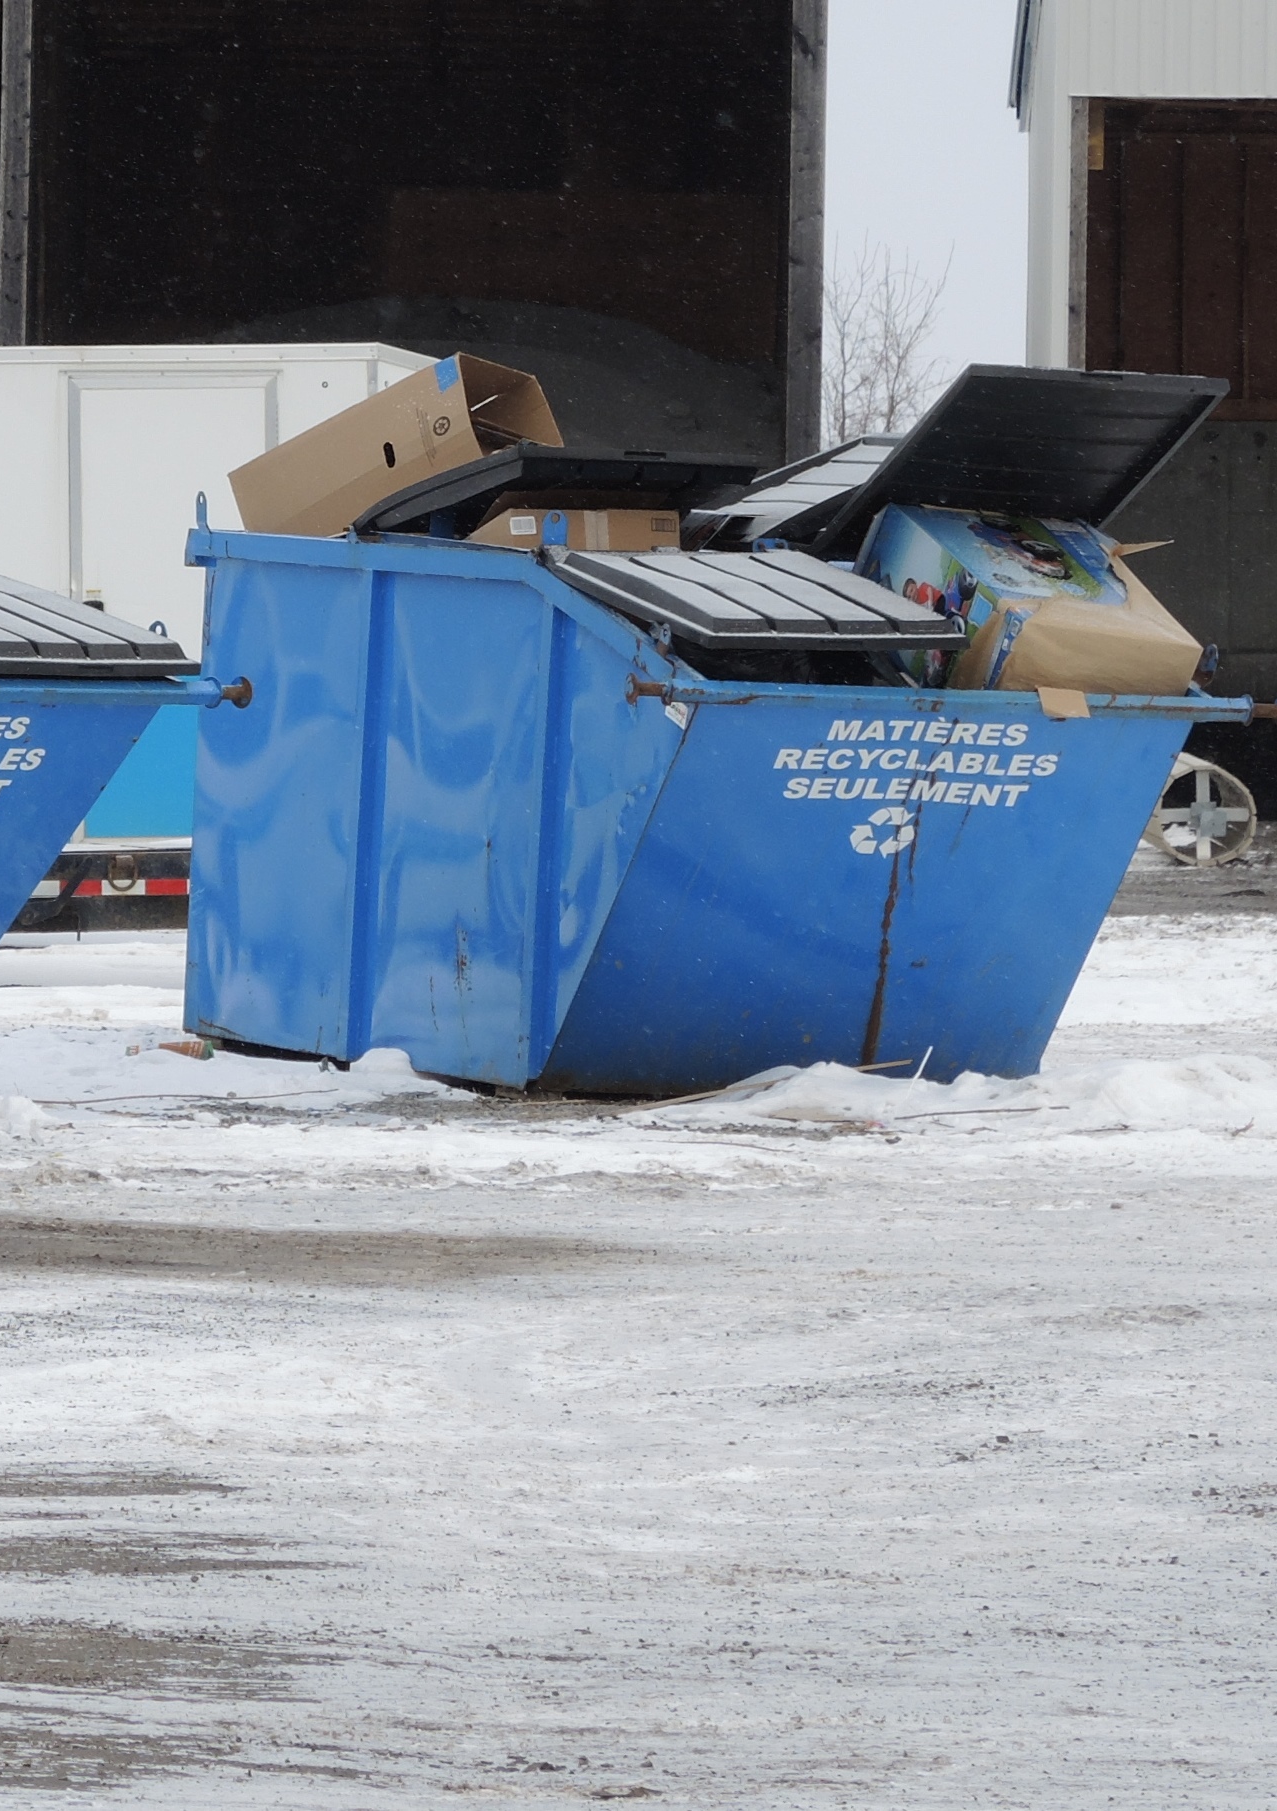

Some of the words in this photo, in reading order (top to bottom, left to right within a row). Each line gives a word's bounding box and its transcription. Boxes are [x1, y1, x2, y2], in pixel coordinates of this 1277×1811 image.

[826, 716, 1029, 747] MATIÈRES
[773, 748, 1058, 777] RECYCLABLES
[782, 777, 1030, 808] SEULEMENT
